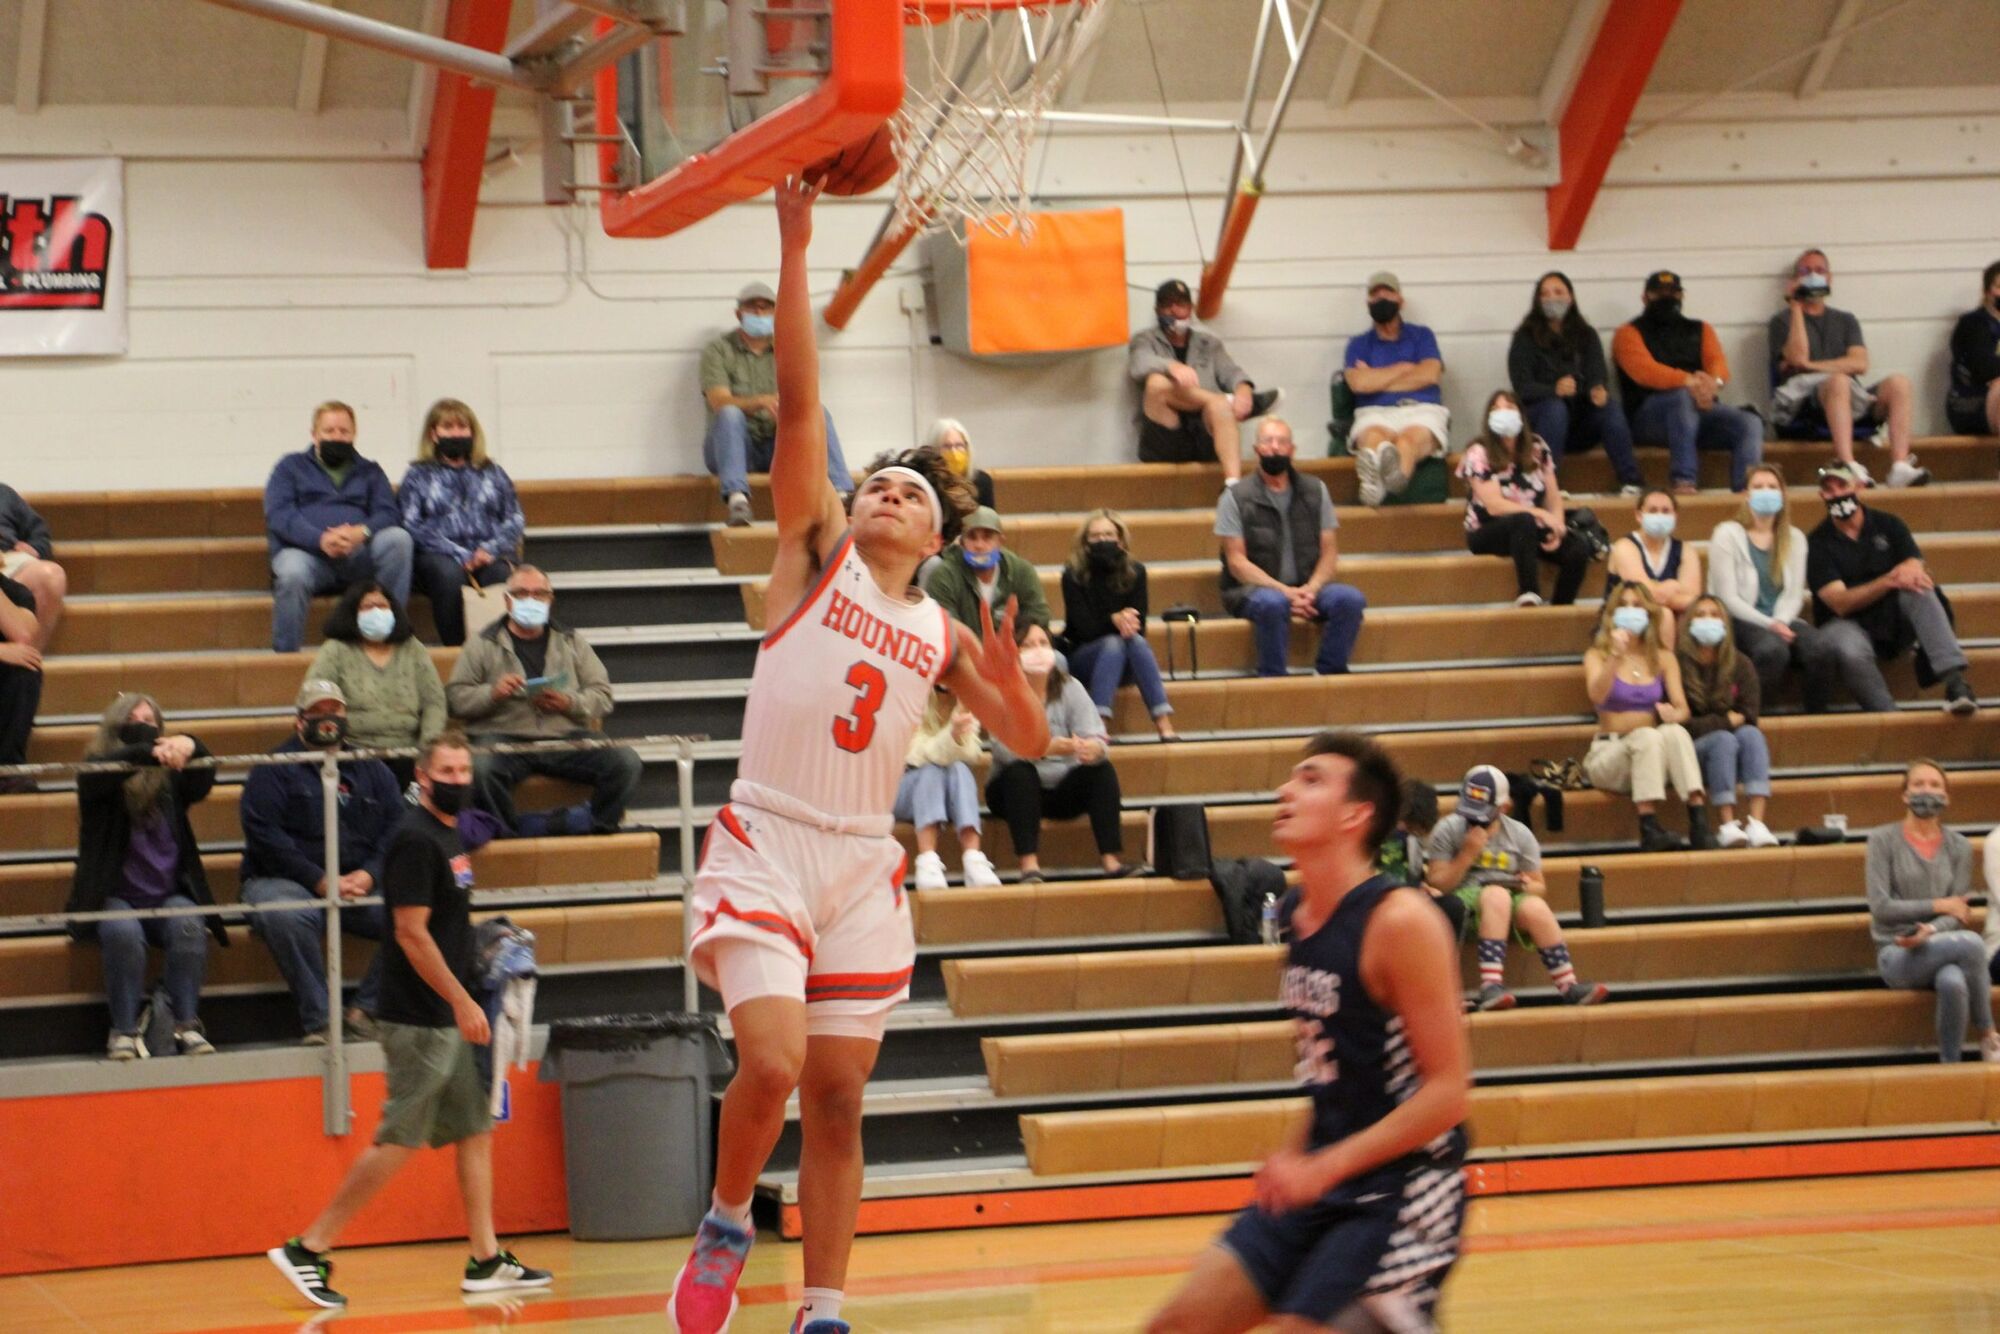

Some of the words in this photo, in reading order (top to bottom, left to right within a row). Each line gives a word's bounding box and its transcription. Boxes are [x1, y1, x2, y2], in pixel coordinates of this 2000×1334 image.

[0, 193, 112, 272] th
[22, 271, 101, 290] PLUMBING
[821, 588, 938, 679] HOUNDS
[831, 659, 888, 754] 3
